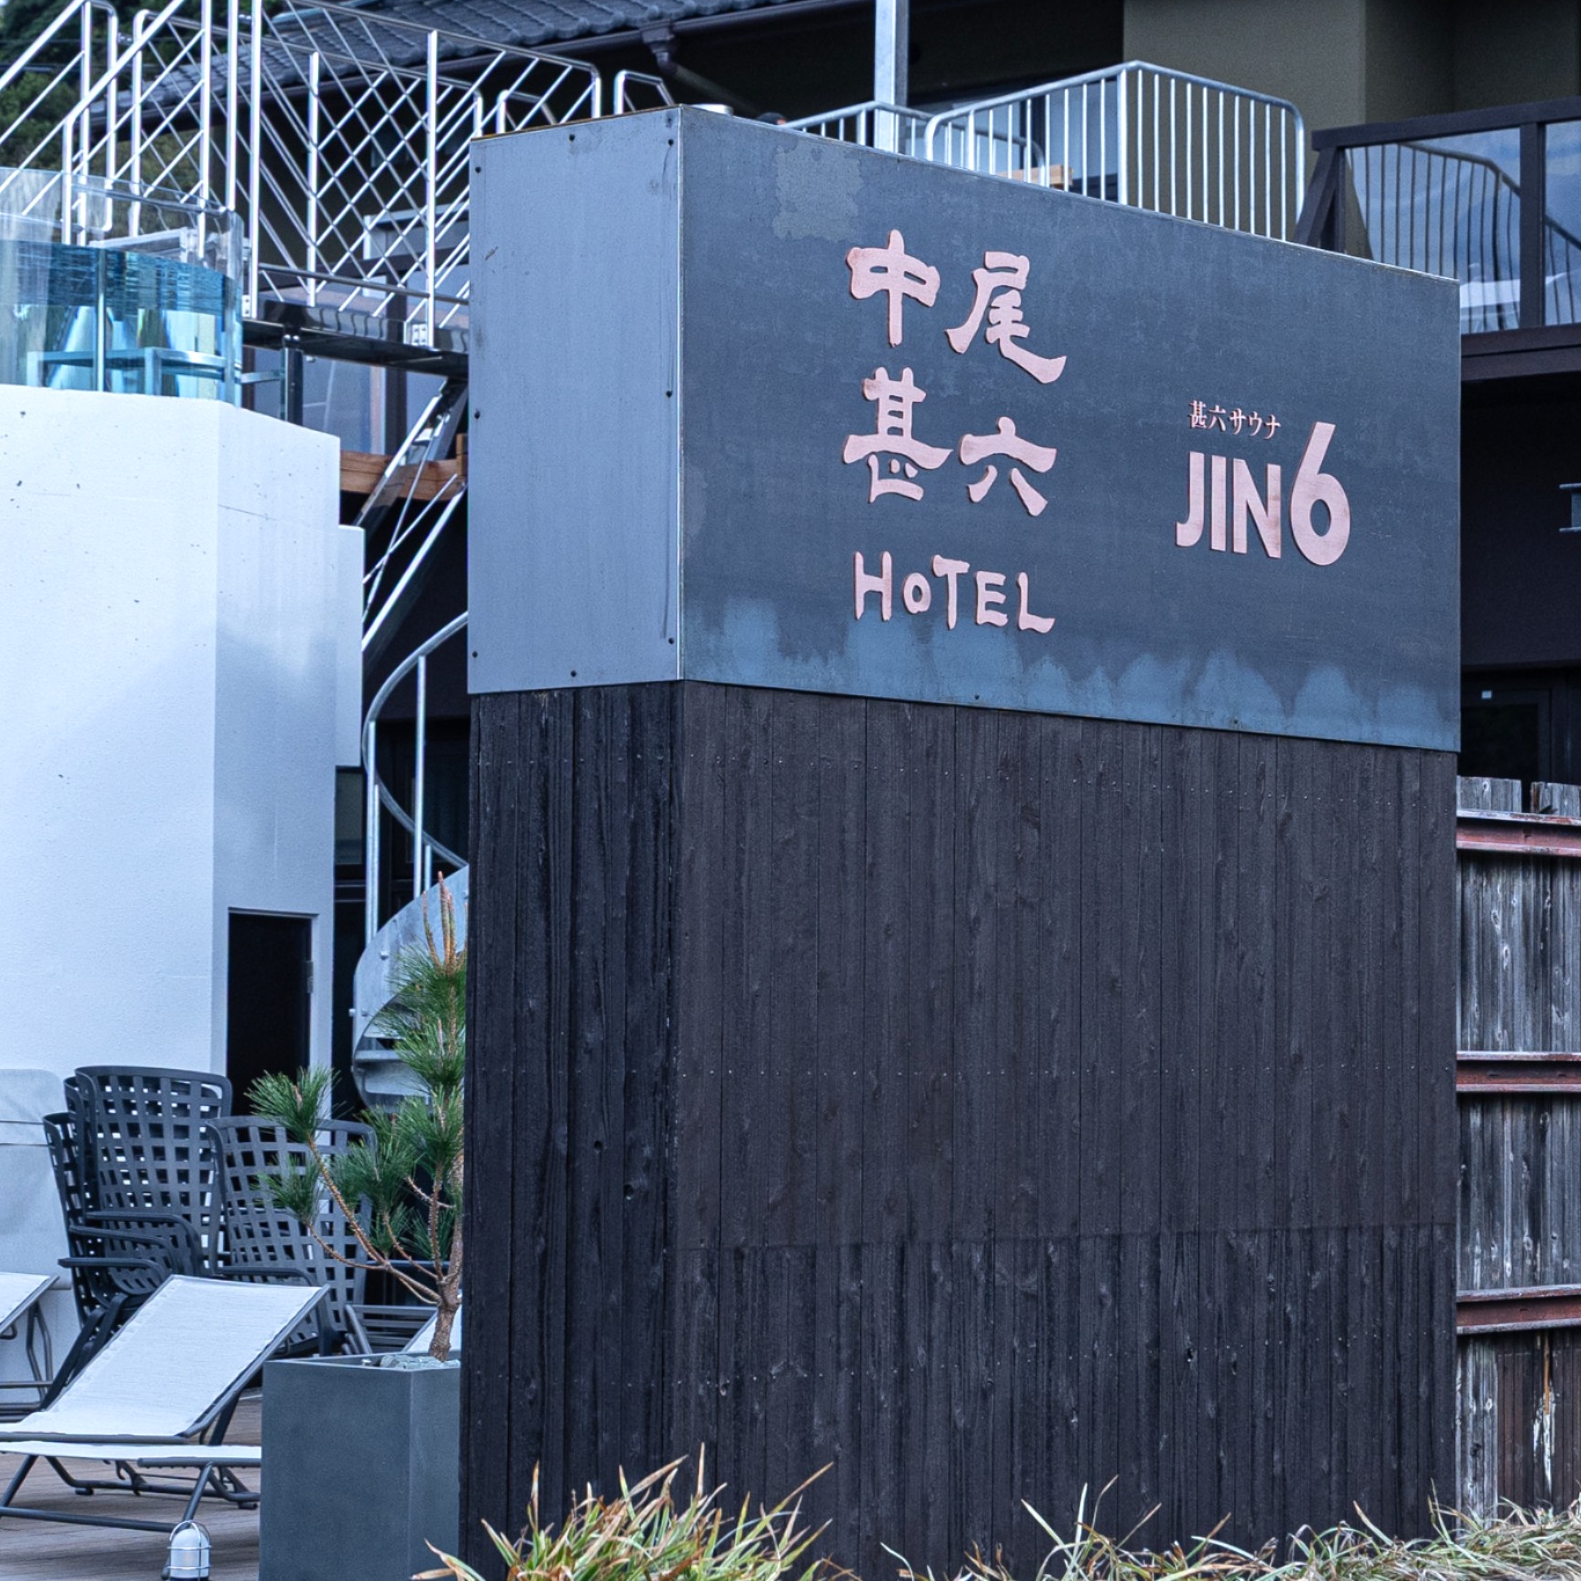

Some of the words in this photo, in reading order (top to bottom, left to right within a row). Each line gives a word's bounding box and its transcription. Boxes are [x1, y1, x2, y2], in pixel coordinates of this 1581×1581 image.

[846, 228, 1067, 384] 中尾
[843, 366, 1057, 517] 甚六
[1176, 421, 1351, 566] JIN6
[1188, 399, 1281, 440] 甚六サウナ
